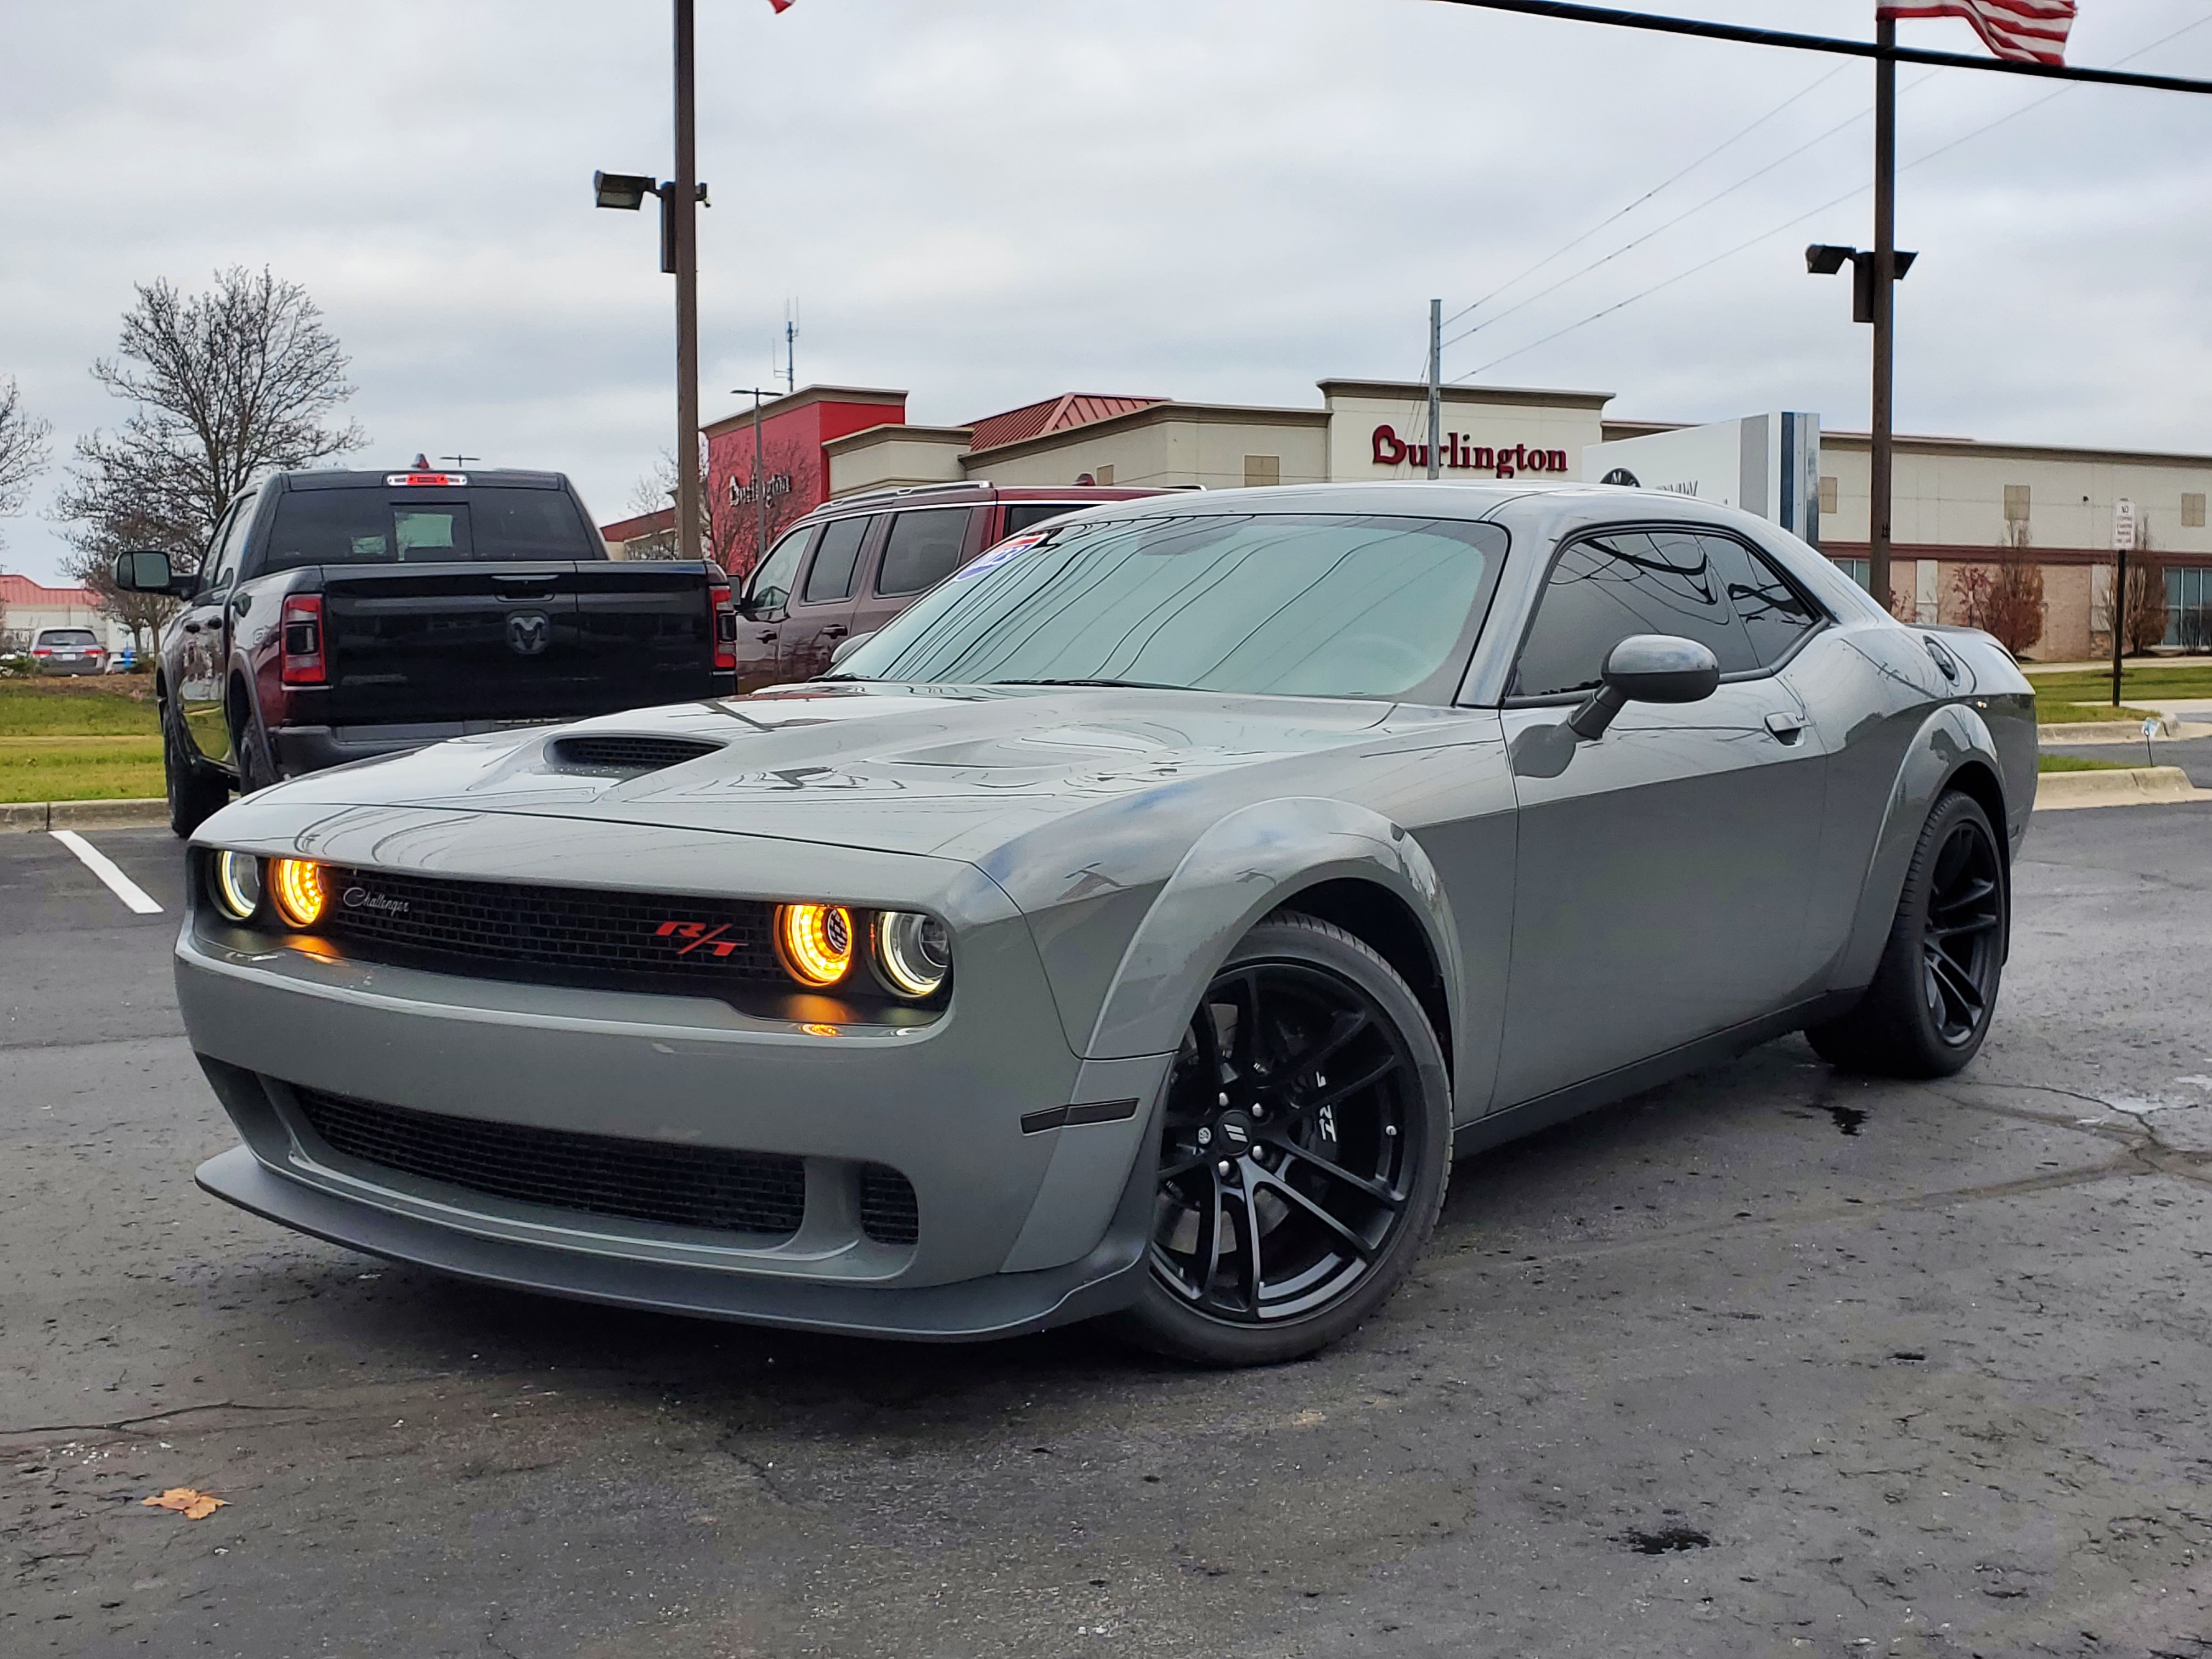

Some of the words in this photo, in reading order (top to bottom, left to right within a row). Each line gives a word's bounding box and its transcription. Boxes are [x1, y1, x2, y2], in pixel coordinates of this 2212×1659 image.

[1372, 425, 1568, 478] Burlington
[730, 473, 791, 509] Burlgton
[343, 887, 410, 917] Challenger
[656, 921, 748, 956] R/T
